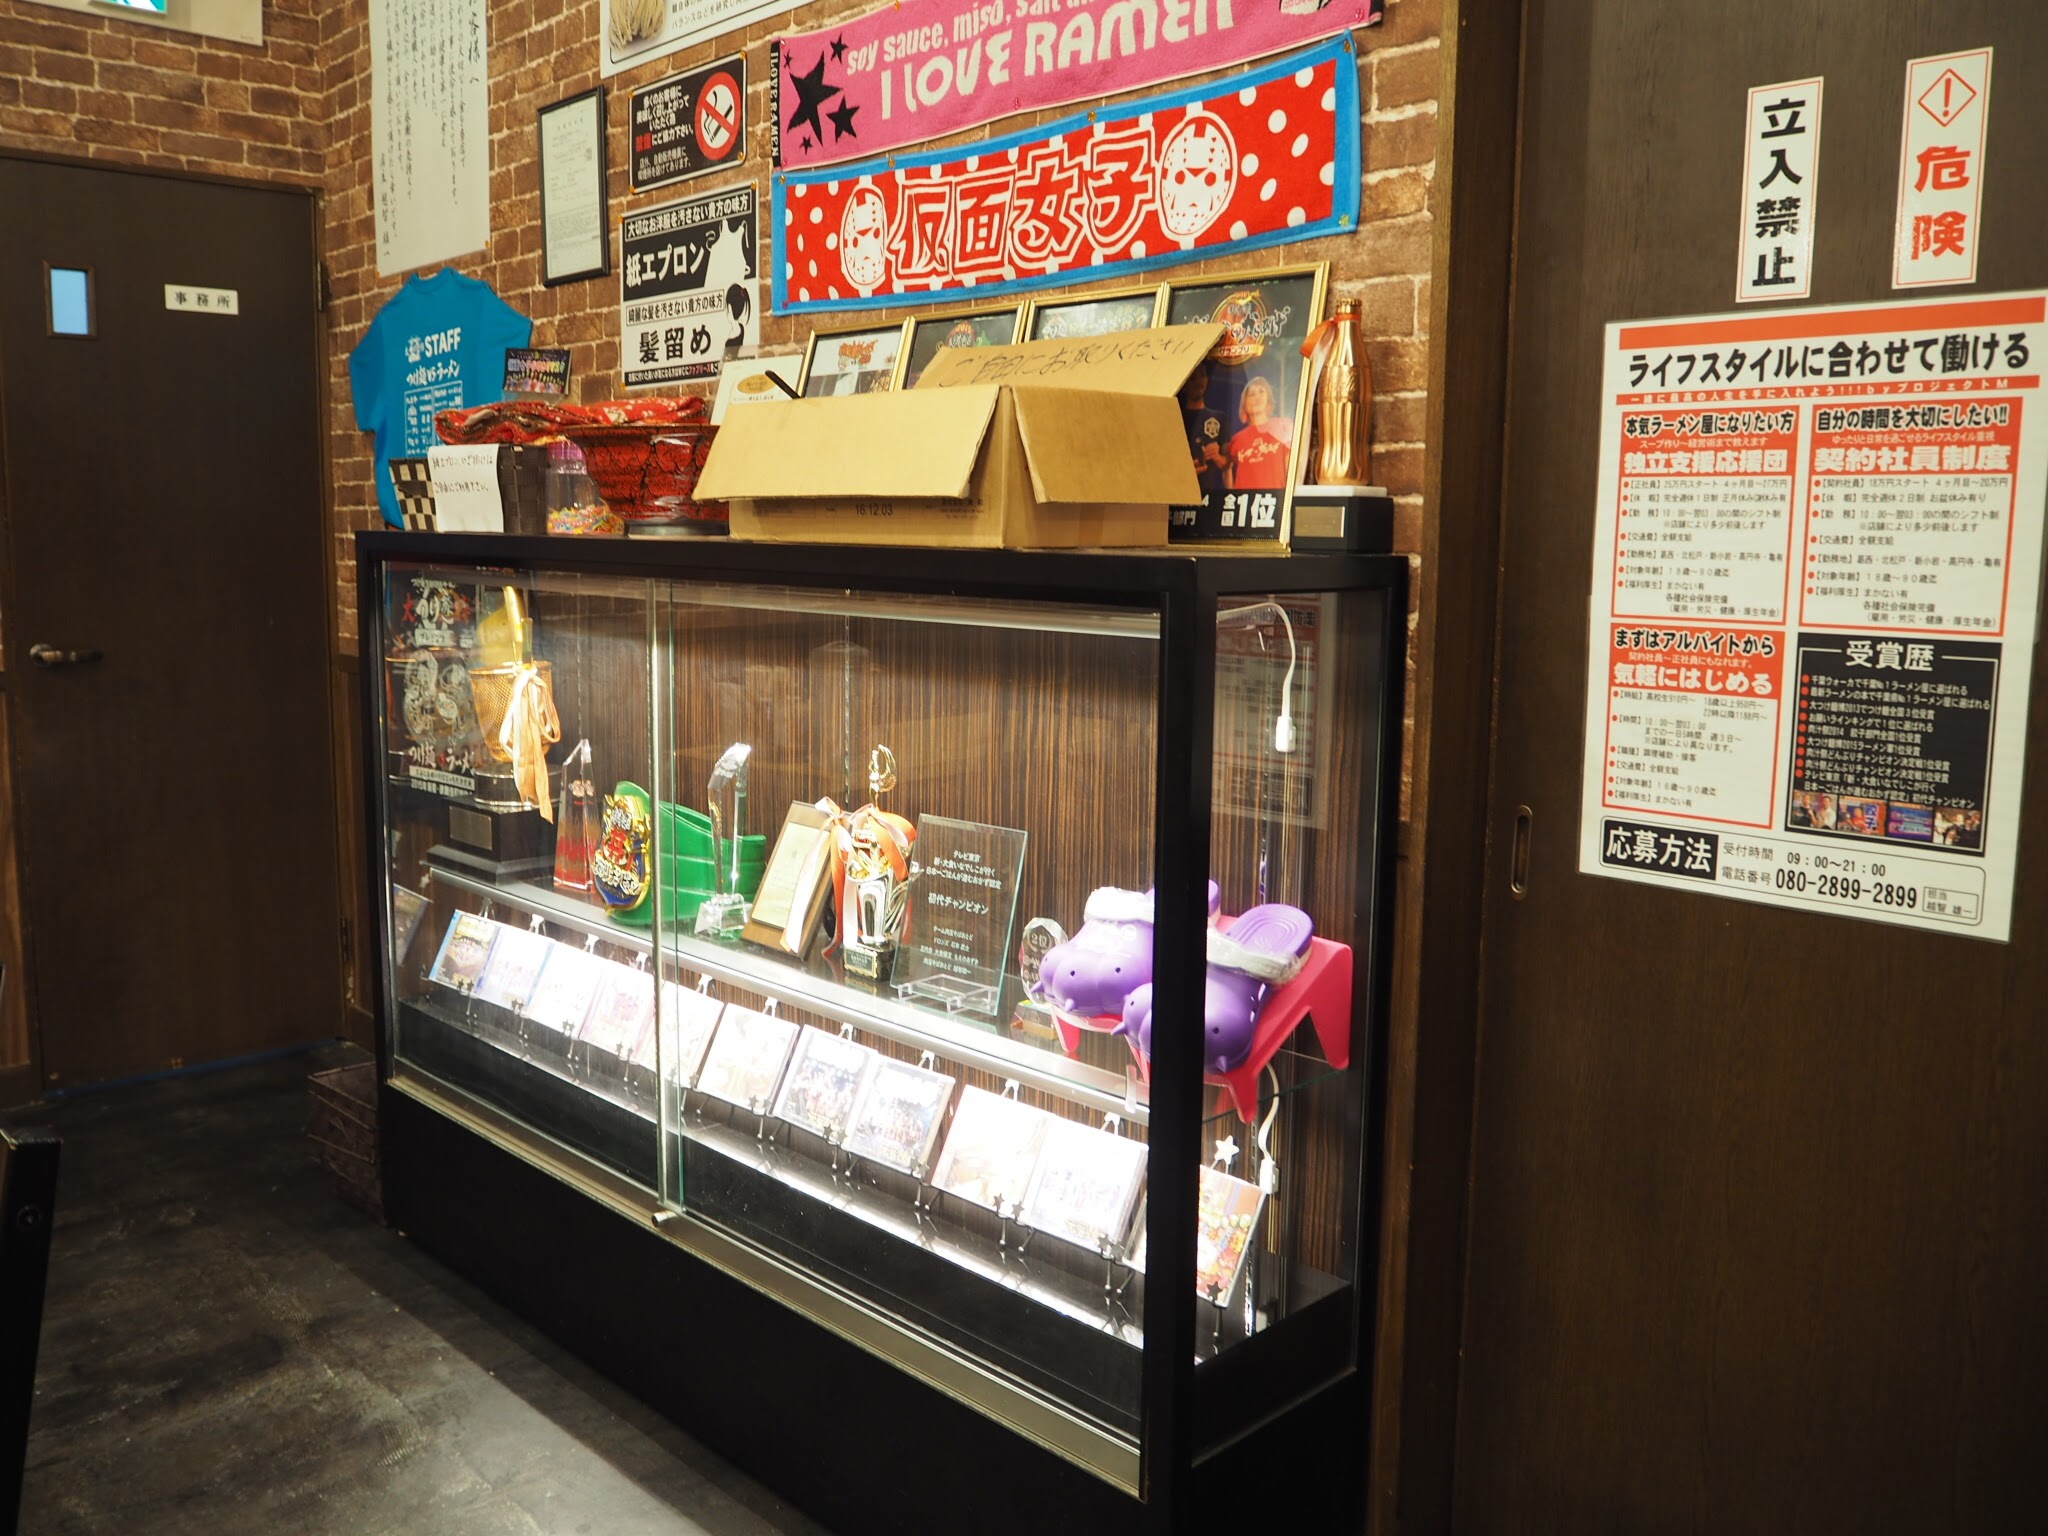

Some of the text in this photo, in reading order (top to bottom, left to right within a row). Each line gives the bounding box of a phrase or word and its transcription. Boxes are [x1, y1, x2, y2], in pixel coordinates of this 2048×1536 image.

[847, 39, 879, 76] soy
[883, 22, 949, 62] sauce,
[881, 70, 891, 120] I
[889, 127, 1157, 287] 仮面女子
[1752, 98, 1807, 287] 立入禁止
[1911, 146, 1971, 260] 危険
[626, 241, 705, 288] 紙エプロン
[175, 291, 231, 308] 事務所
[425, 327, 461, 358] STAFF
[639, 324, 711, 364] 髪留め
[1629, 330, 2031, 388] ライフスタイルに合わせて働ける
[1625, 411, 1794, 436] 本気ラーメン屋になりたい方
[1817, 403, 2007, 431] 自分の時間を大切にしたい!!
[1624, 449, 1787, 474] 独立支援応援団
[1814, 444, 2011, 472] 契約社員制度
[855, 503, 893, 516] 16.12.03
[1615, 628, 1774, 656] まずはアルバイトから
[1845, 639, 1935, 672] 受賞歴
[1613, 663, 1772, 695] 気軽にはじめる
[1606, 825, 1713, 873] 応募方法
[1723, 842, 1773, 861] 受付時間
[928, 892, 990, 915] 初代チャンピオン
[1722, 866, 1917, 909] 電話番号 080-2899-2899
